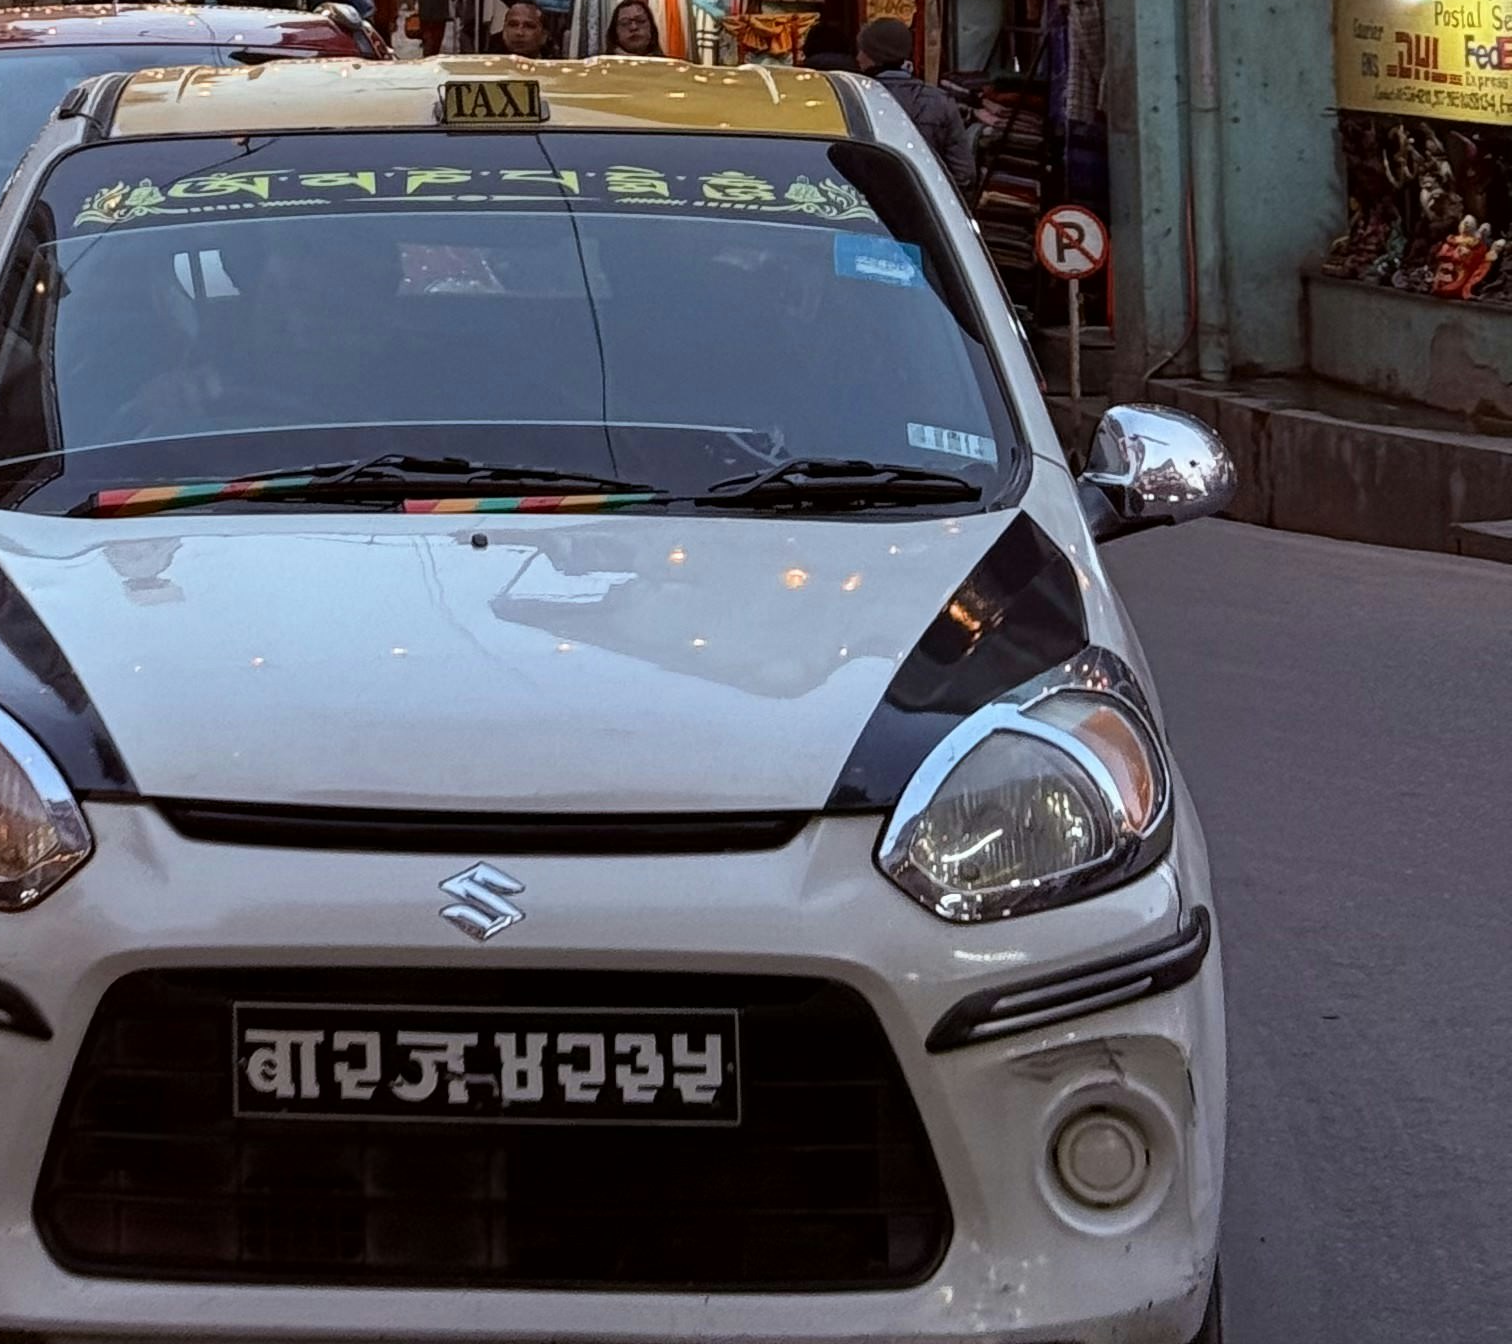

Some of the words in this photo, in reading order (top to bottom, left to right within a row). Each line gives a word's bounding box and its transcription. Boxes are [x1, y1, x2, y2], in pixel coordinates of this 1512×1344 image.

[1434, 0, 1482, 28] Postal
[447, 83, 539, 117] TAXI
[1055, 221, 1085, 263] P
